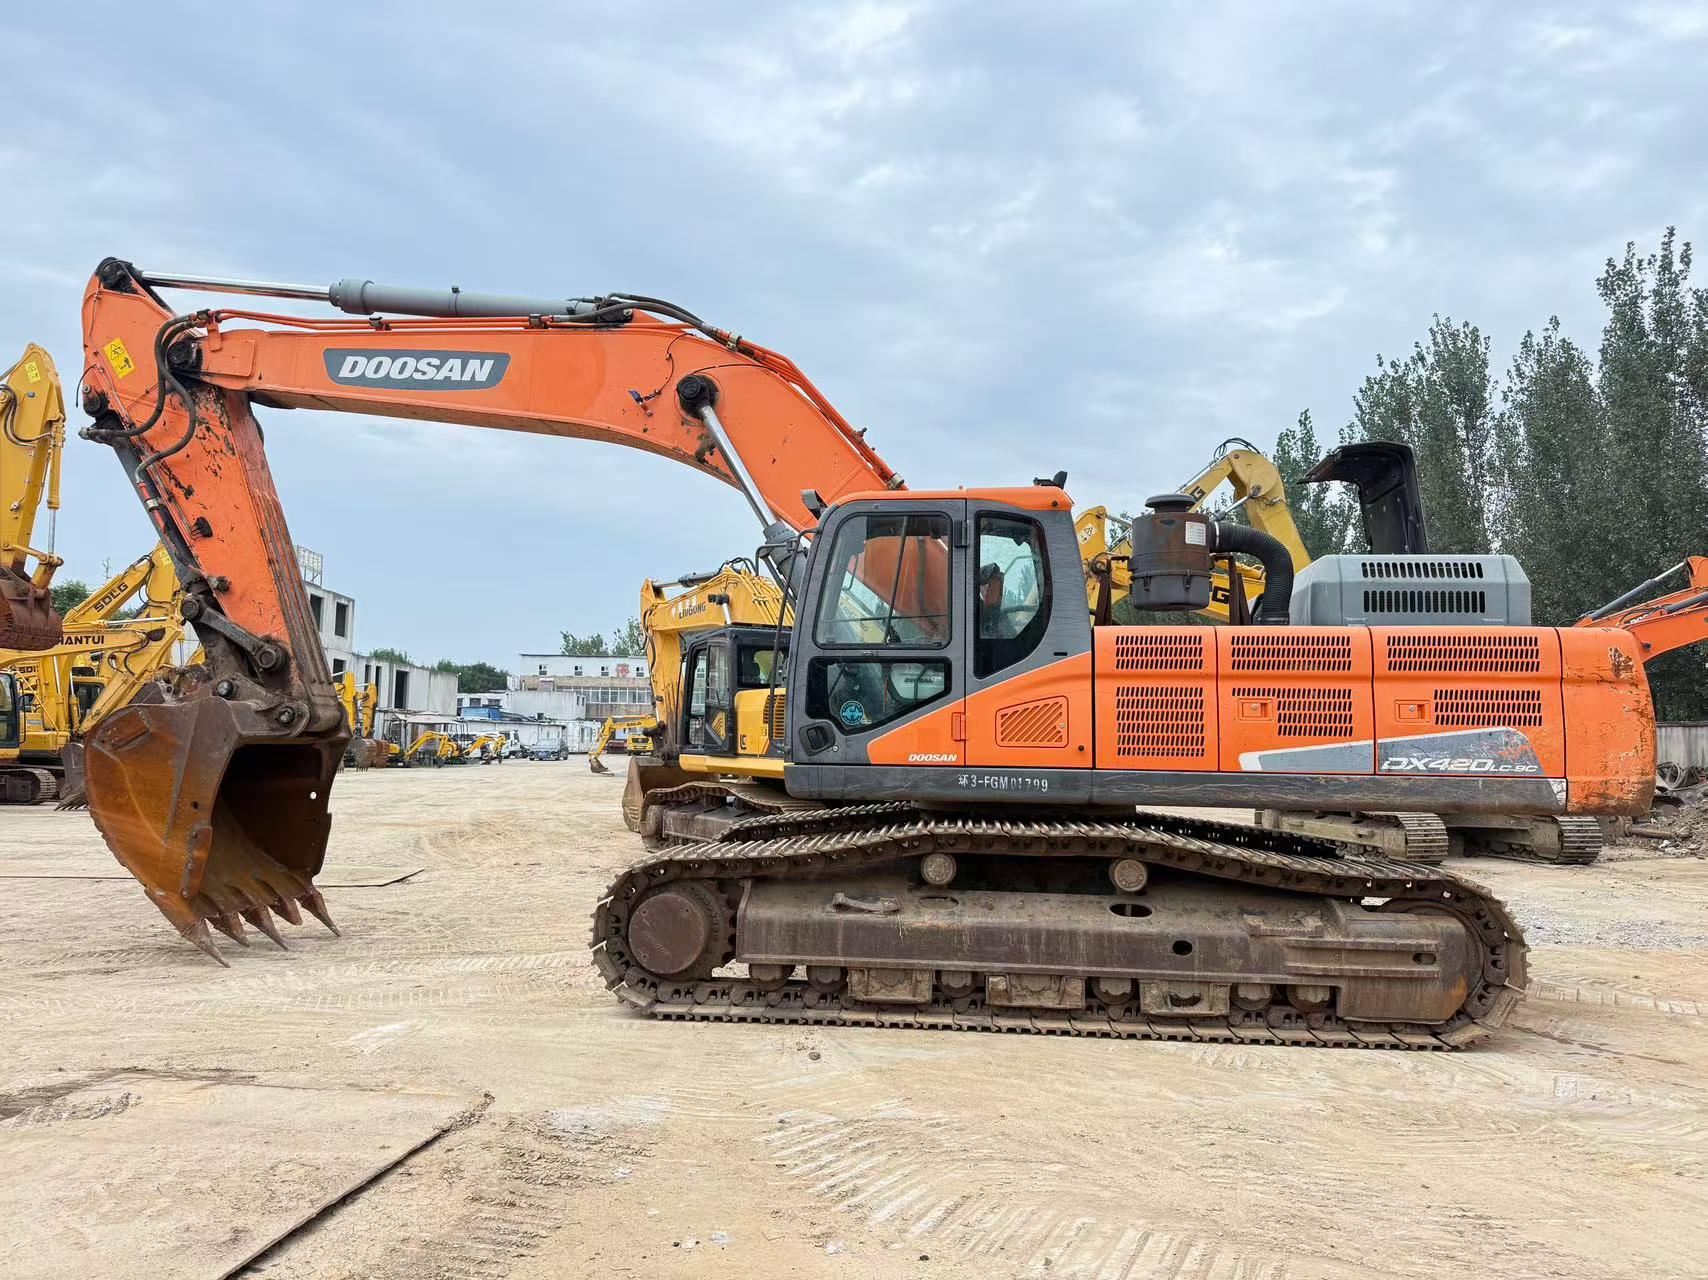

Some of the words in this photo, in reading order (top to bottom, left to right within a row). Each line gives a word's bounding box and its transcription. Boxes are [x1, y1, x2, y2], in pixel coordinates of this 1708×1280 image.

[338, 355, 494, 382] DOOSAN
[93, 581, 129, 613] SDLG
[678, 601, 706, 619] LIUGONG
[908, 753, 957, 762] DOOSAN
